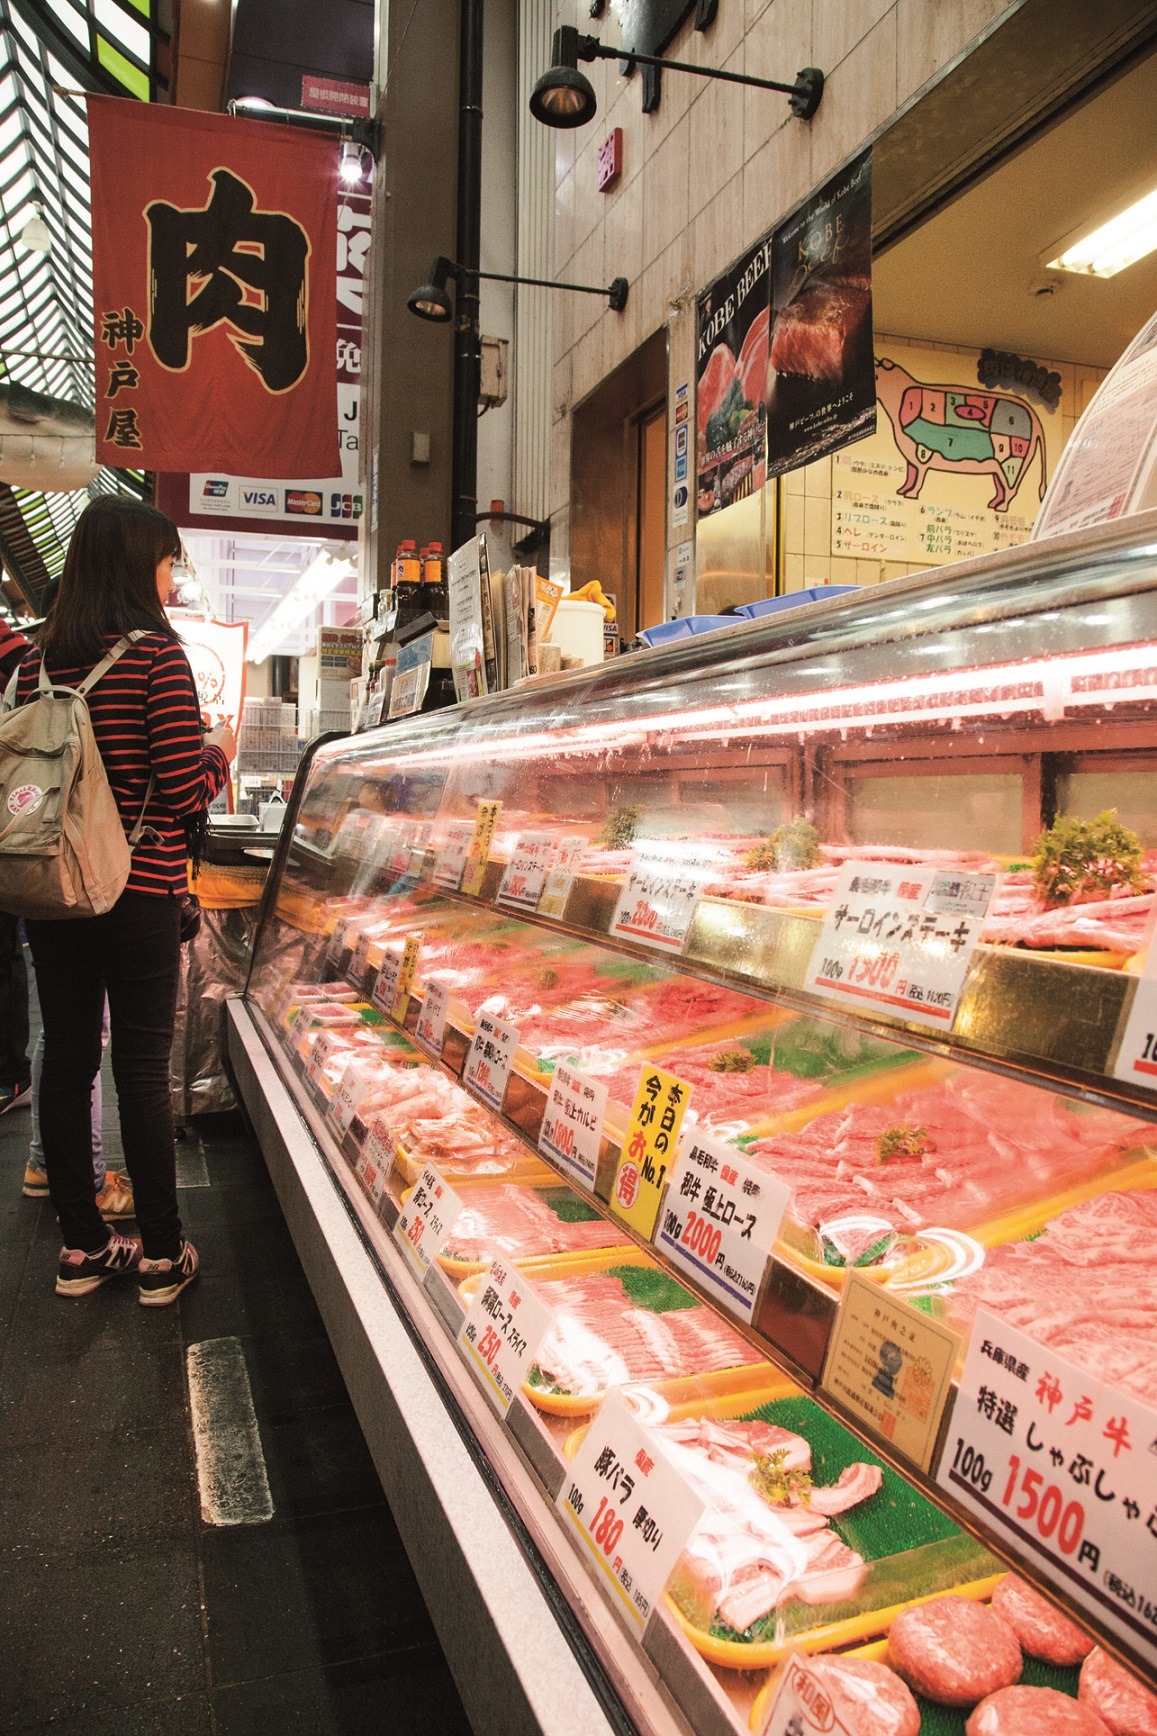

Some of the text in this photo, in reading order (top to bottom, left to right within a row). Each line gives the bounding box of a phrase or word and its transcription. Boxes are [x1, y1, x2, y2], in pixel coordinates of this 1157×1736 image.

[799, 213, 842, 260] KOBE
[142, 167, 312, 395] 肉
[698, 294, 735, 361] KOBE
[100, 306, 145, 450] 神戸屋
[1014, 444, 1022, 452] 10
[1007, 465, 1015, 474] 11
[243, 491, 276, 506] VISA
[287, 498, 321, 507] MasterCard
[331, 500, 362, 512] JCB
[837, 490, 842, 499] 2
[844, 540, 887, 553] サーロイン
[927, 534, 952, 545] 中バラ
[834, 905, 970, 953] サーロインステーキ
[679, 1170, 757, 1241] 和牛 極上ロース
[977, 1384, 1019, 1436] 特選
[979, 1339, 1032, 1383] 兵庫県産
[1035, 1370, 1132, 1459] 神戸牛
[635, 1448, 655, 1478] 国産
[952, 1437, 993, 1493] 100g
[568, 1483, 585, 1515] 100g
[594, 1445, 664, 1552] 豚バラ 厚切り
